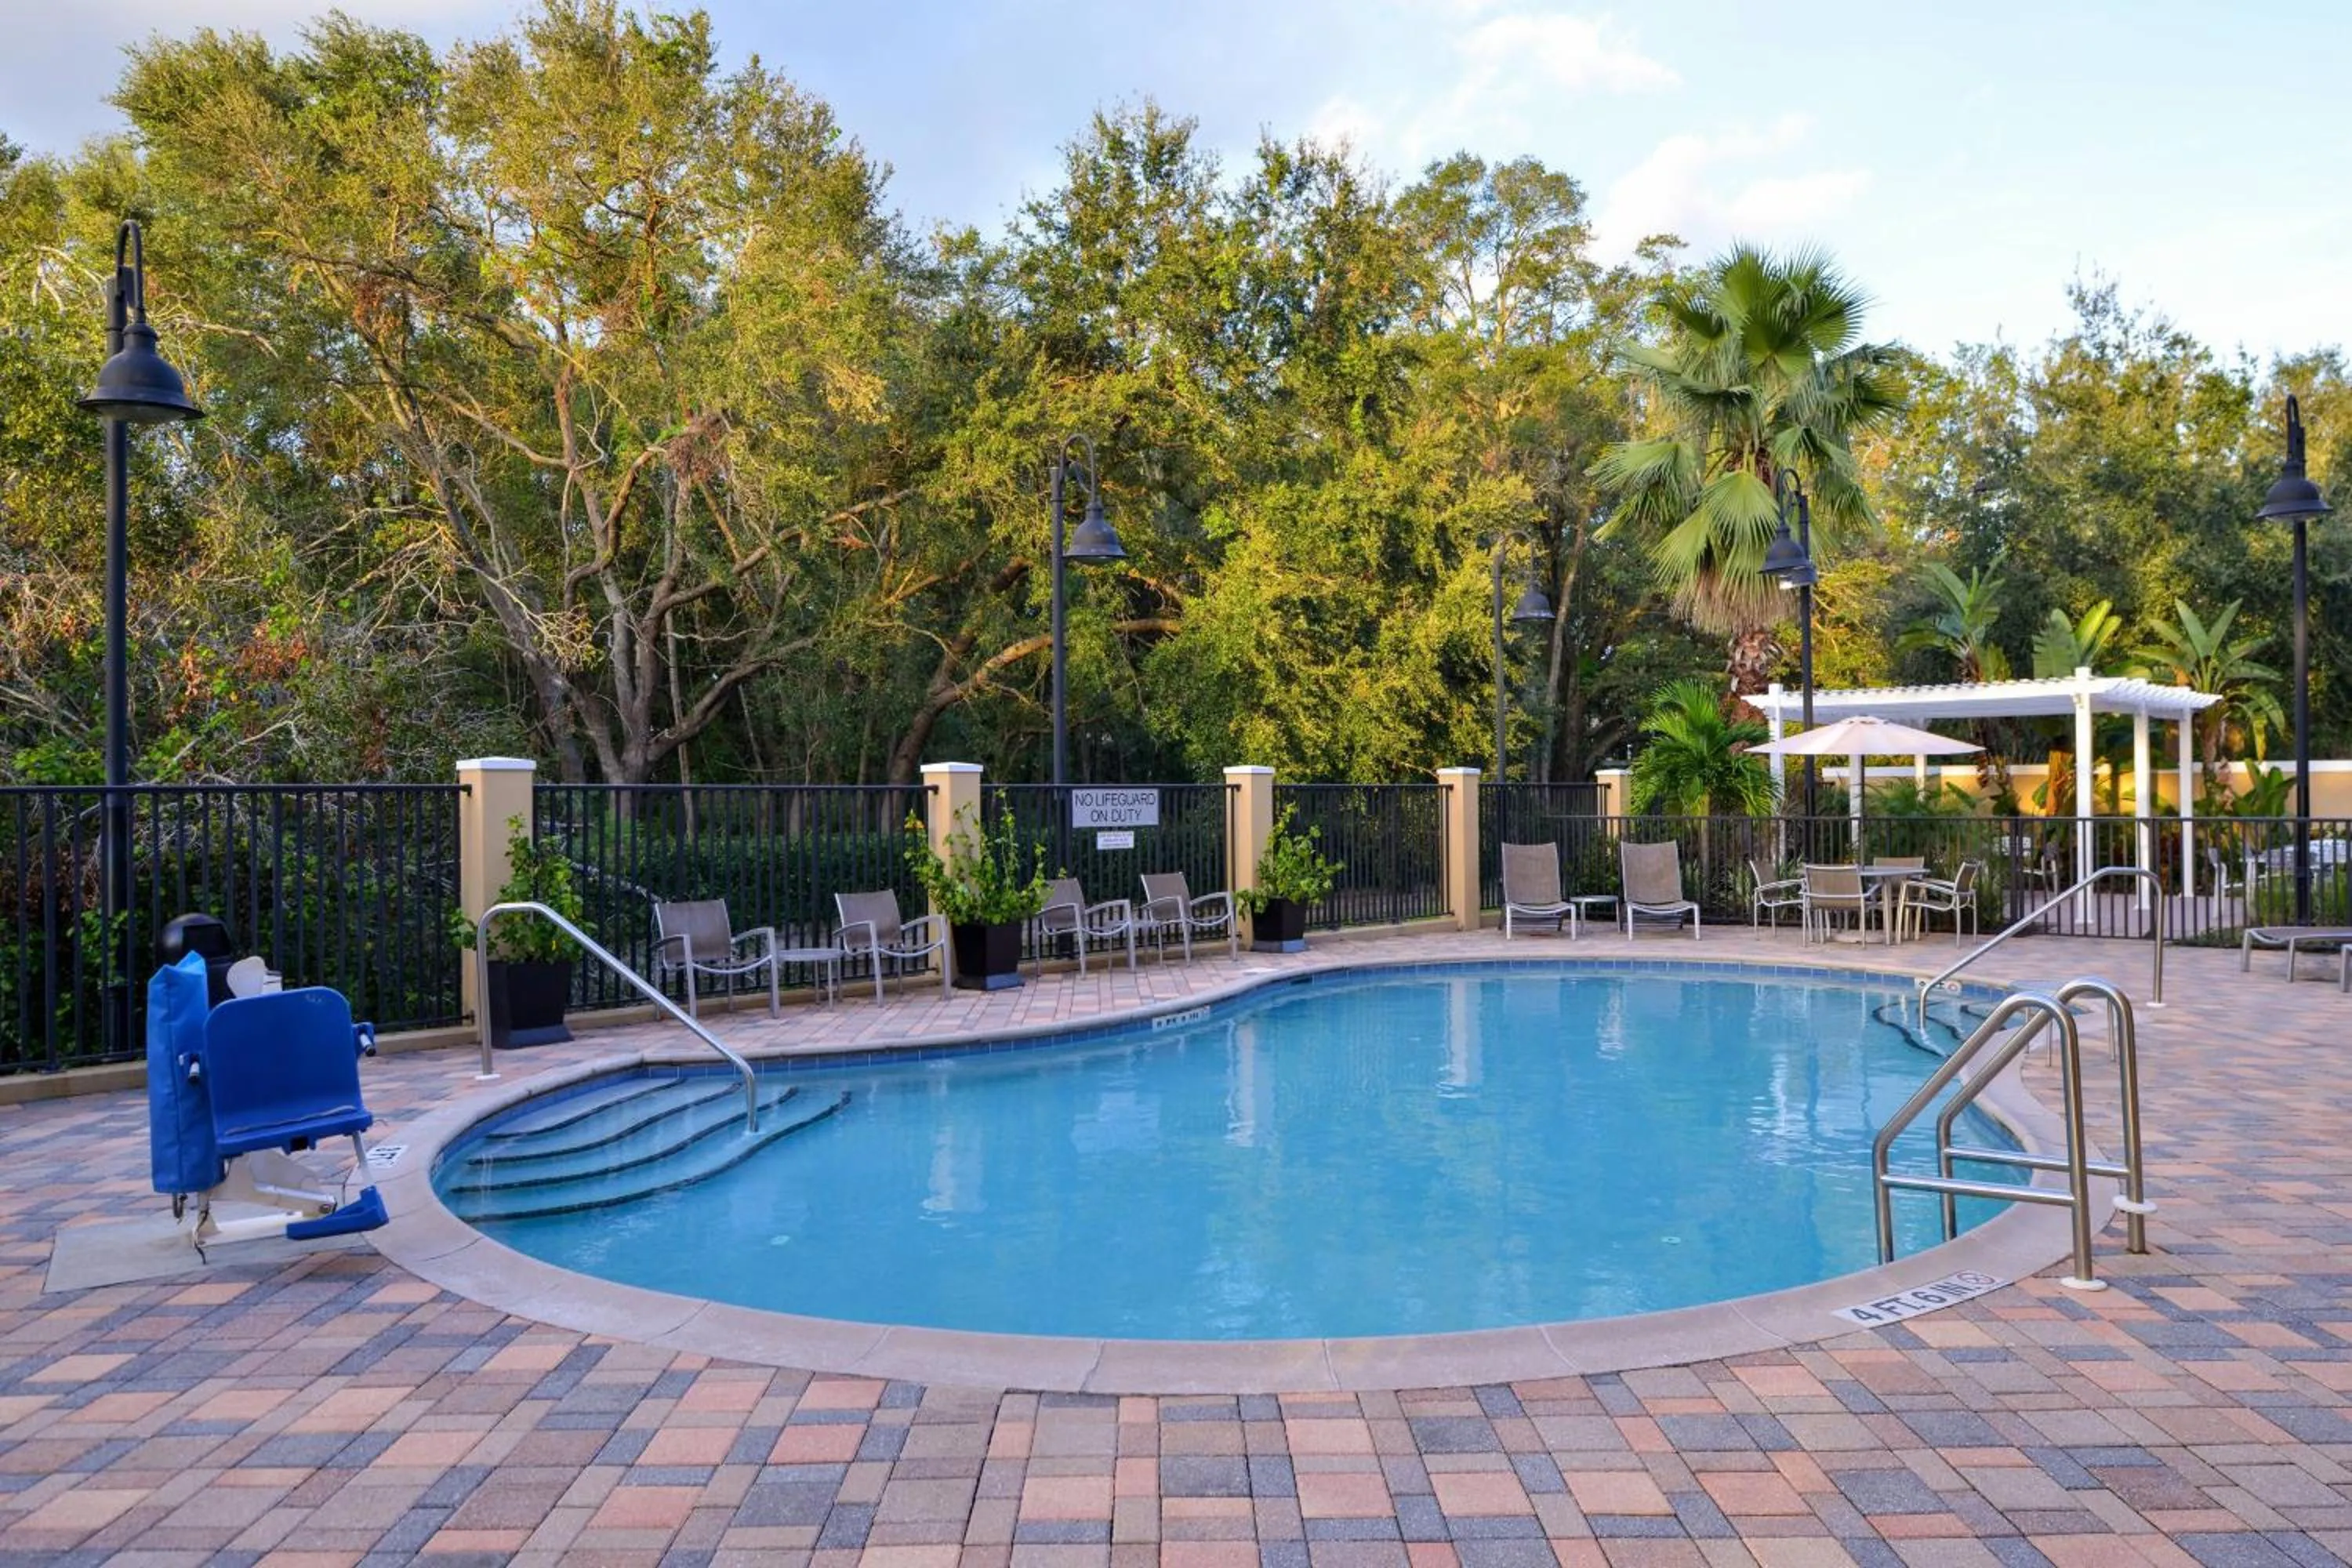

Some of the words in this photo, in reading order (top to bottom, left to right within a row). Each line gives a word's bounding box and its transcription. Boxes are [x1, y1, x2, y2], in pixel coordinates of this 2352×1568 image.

[1075, 793, 1093, 806] NO
[1095, 793, 1156, 806] LIFEGUARD
[1091, 809, 1108, 822] ON
[1111, 809, 1142, 822] DUTY
[1851, 1308, 1884, 1320] 4
[1911, 1291, 1947, 1303] 6
